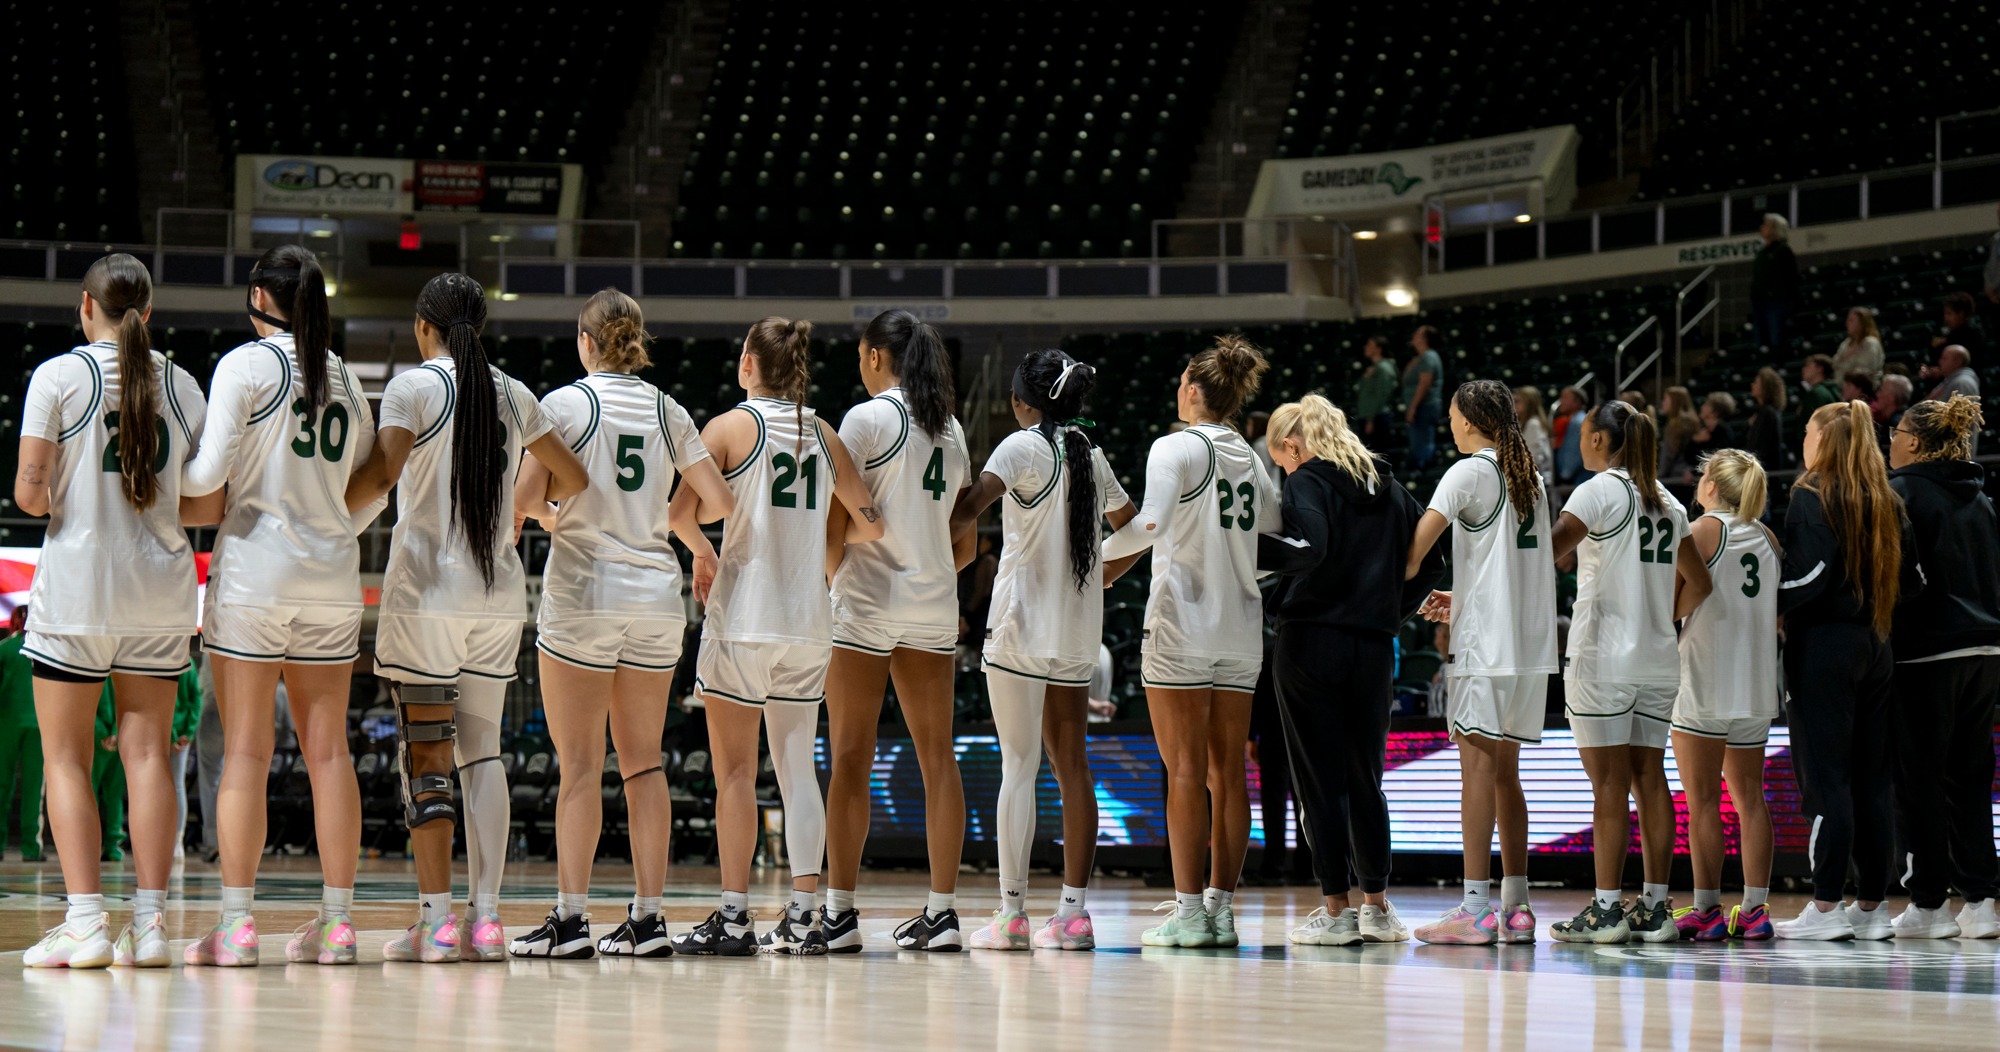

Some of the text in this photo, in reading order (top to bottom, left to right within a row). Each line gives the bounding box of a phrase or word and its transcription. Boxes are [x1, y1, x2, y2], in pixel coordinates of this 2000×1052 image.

[314, 163, 394, 190] Dean
[1302, 166, 1377, 189] GAMEDAY
[291, 397, 349, 462] 30
[616, 434, 645, 492] 5
[771, 452, 817, 510] 21
[922, 447, 946, 501] 4
[1217, 478, 1256, 532] 23
[1516, 511, 1538, 549] 2
[1638, 515, 1674, 565] 22
[1740, 552, 1760, 598] 3
